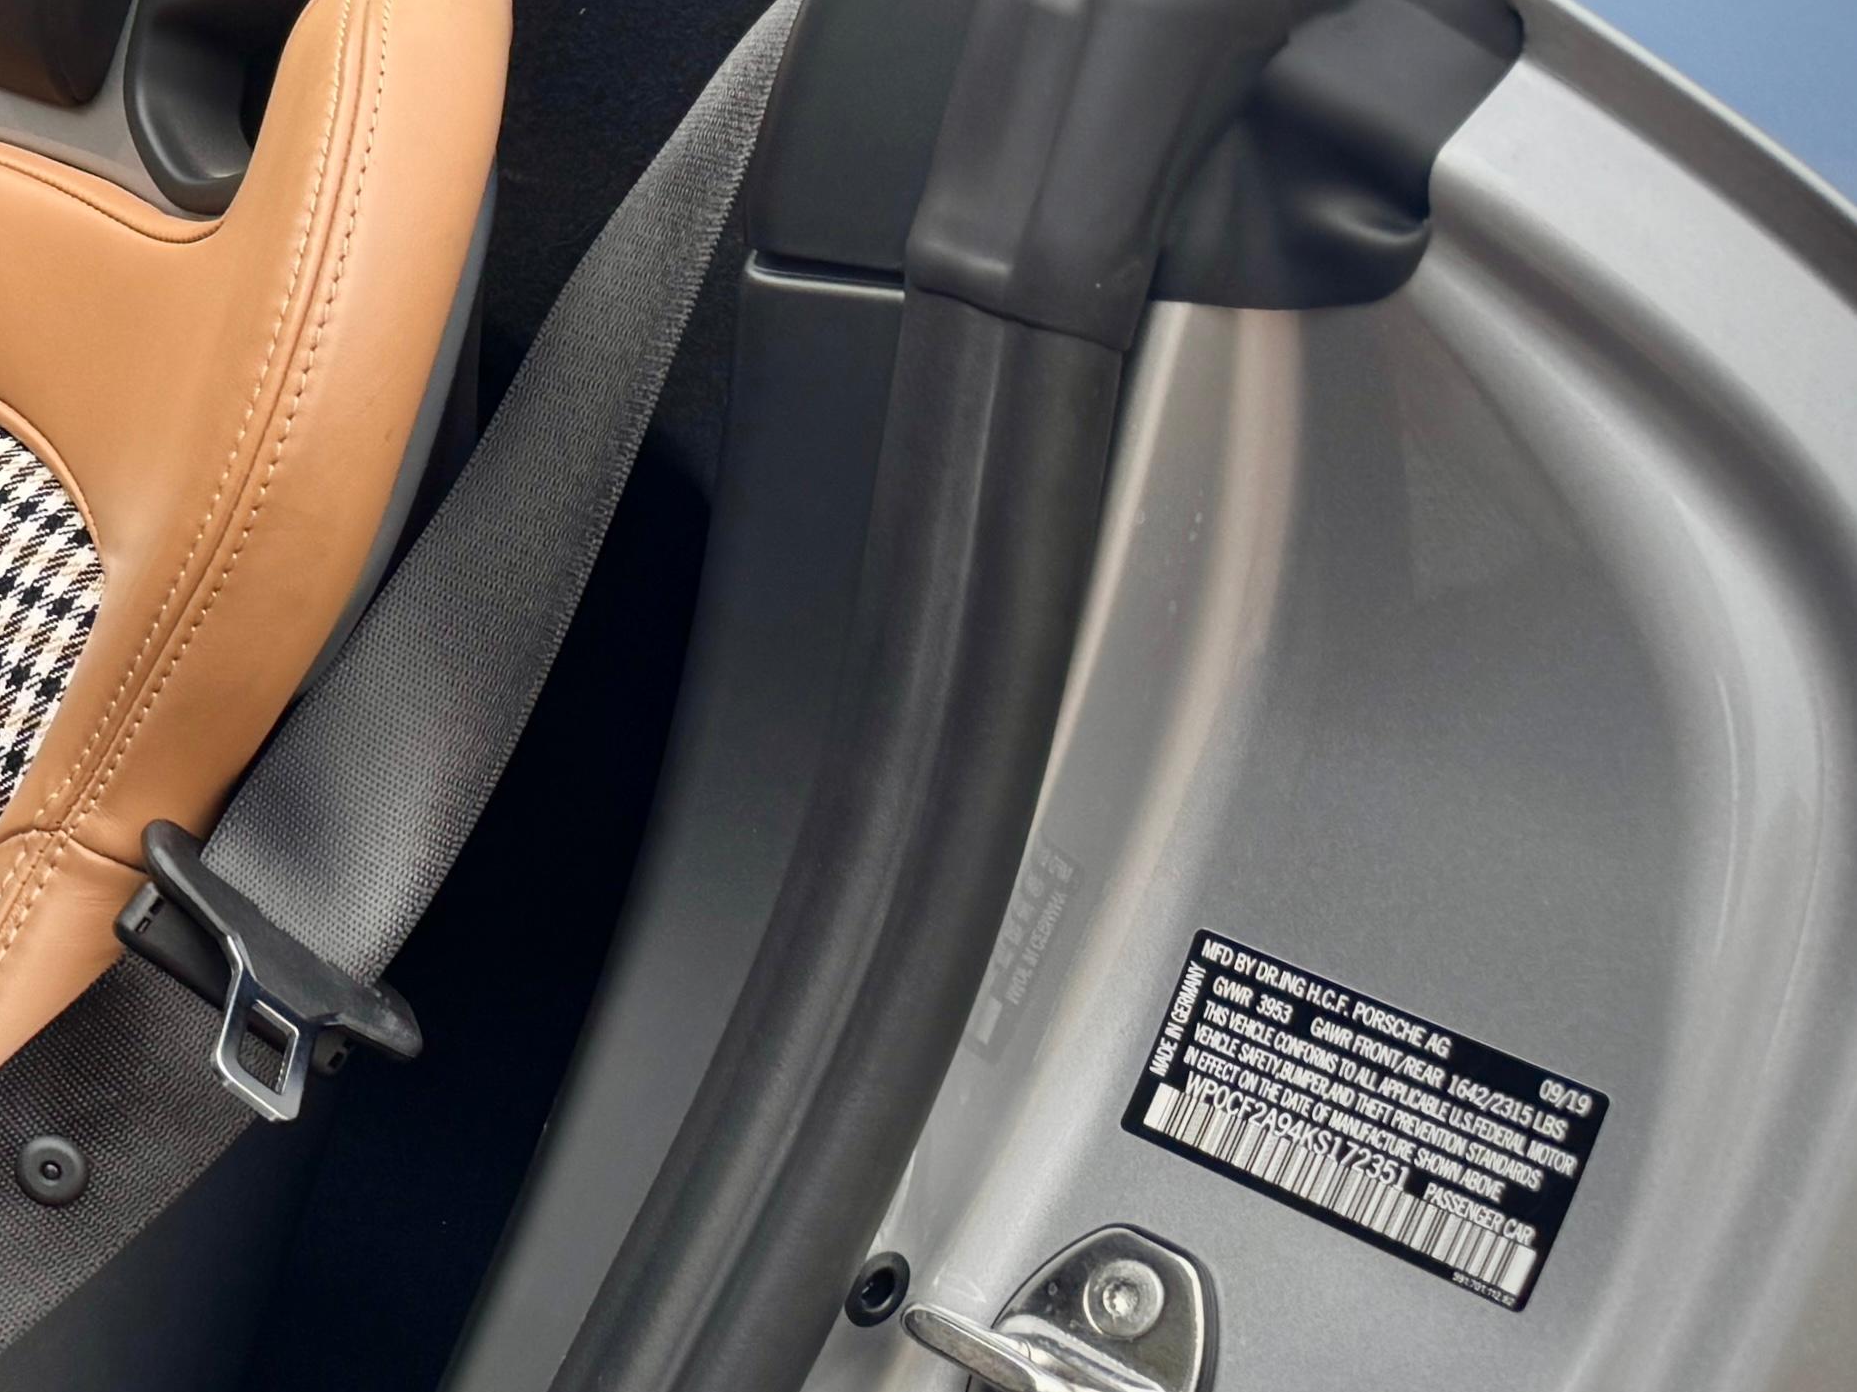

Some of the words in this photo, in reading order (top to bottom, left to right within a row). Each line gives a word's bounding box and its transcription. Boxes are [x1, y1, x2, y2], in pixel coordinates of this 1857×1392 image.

[1163, 1021, 1184, 1040] IN
[1169, 960, 1208, 1025] GERMANY
[1199, 937, 1235, 968] MFD
[1232, 951, 1257, 977] BY
[1254, 960, 1308, 998] DR.ING
[1304, 981, 1354, 1017] H.C.F.
[1350, 999, 1427, 1047] PORSCHE
[1423, 1030, 1454, 1059] AG
[1148, 1036, 1178, 1078] MADE
[1200, 999, 1230, 1027] THIS
[1226, 1010, 1276, 1047] VEHICLE
[1271, 1029, 1340, 1074] CONFORMS
[1335, 1057, 1358, 1082] TO
[1352, 1064, 1381, 1092] ALL
[1376, 1074, 1452, 1122] APPLICABLE
[1525, 1138, 1580, 1177] MOTOR
[1210, 974, 1255, 1008] GVWR
[1254, 992, 1295, 1025] 3953
[1307, 1015, 1355, 1050] GAWR
[1349, 1033, 1448, 1091] FRONT/REAR
[1444, 1072, 1536, 1128] 1642/2315
[1531, 1108, 1571, 1141] LBS
[1535, 1077, 1595, 1119] 09/19
[1182, 1044, 1199, 1066] IN
[1196, 1050, 1239, 1084] EFFECT
[1236, 1068, 1259, 1093] ON
[1255, 1076, 1283, 1103] THE
[1279, 1087, 1314, 1117] DATE
[1309, 1100, 1332, 1125] OF
[1327, 1108, 1417, 1163] MANUFACTURE
[1412, 1145, 1465, 1184] SHOWN
[1458, 1166, 1507, 1202] ABOVE
[1190, 1021, 1241, 1058] VEHICLE
[1352, 1091, 1394, 1125] THEFT
[1389, 1107, 1470, 1158] PREVENTION
[1463, 1139, 1547, 1191] STANDARDS
[1421, 1180, 1506, 1233] PASSENGER
[1501, 1216, 1537, 1247] CAR
